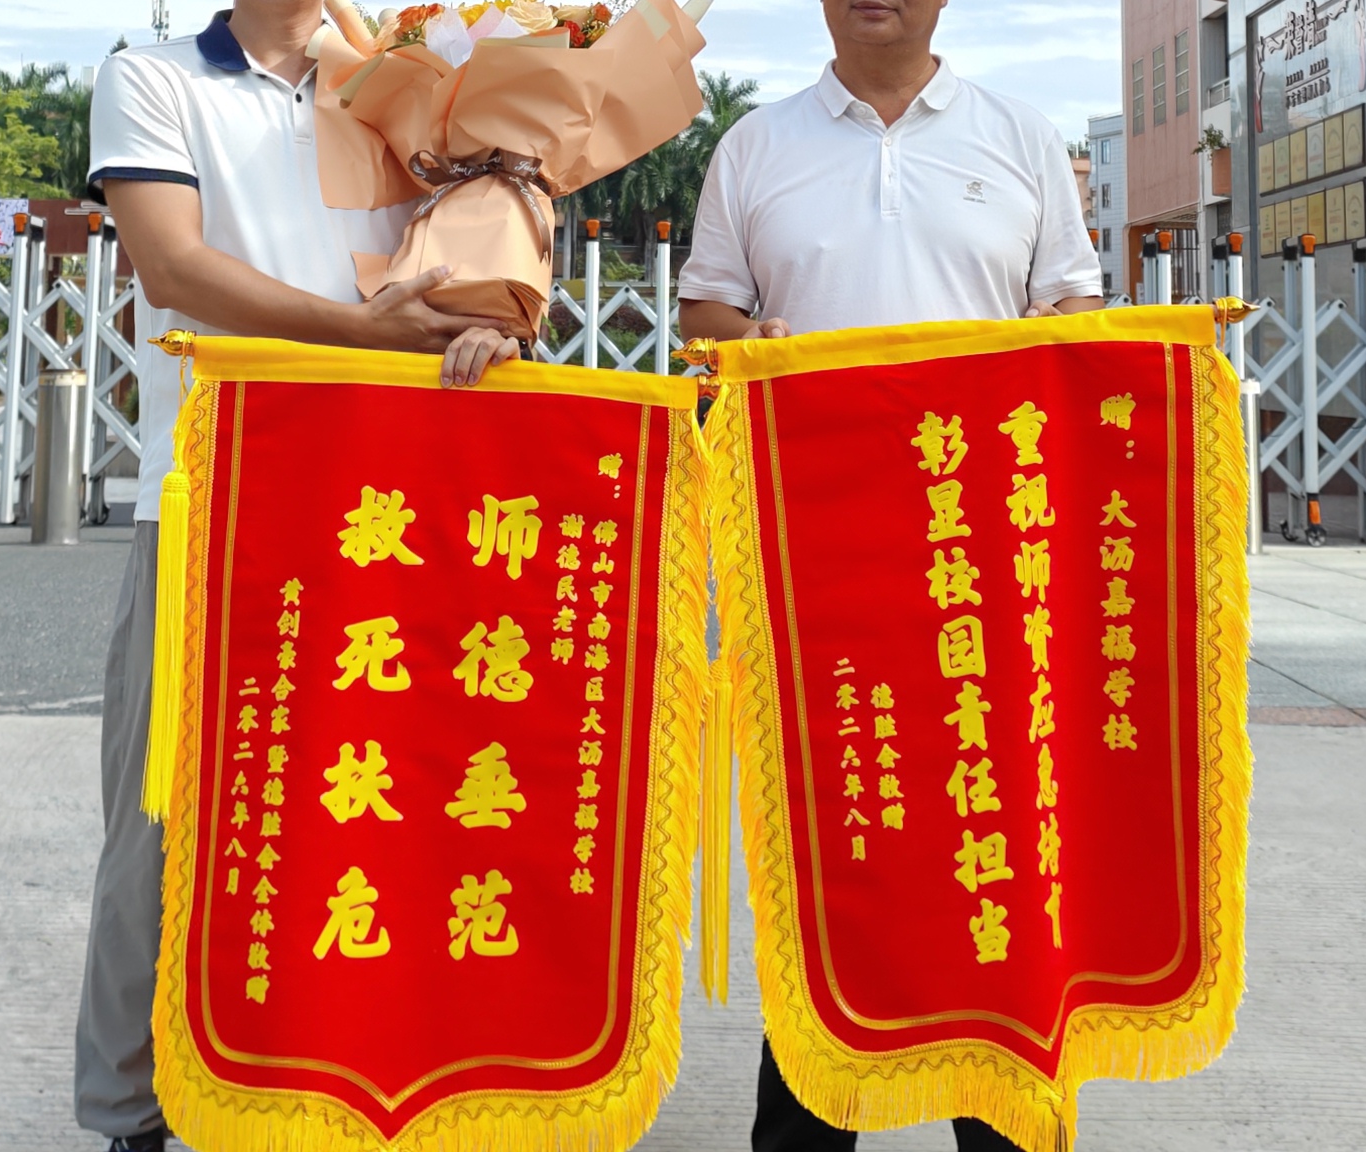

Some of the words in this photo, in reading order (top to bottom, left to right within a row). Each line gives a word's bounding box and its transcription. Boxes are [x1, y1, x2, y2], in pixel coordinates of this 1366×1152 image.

[312, 485, 425, 960] 救死扶危
[444, 493, 543, 961] 师德垂范
[550, 513, 585, 666] 谢德民老师
[569, 520, 620, 896] 佛山市南海区大沥嘉福学校
[910, 410, 1015, 965] 彰显校园责任担当
[1099, 489, 1138, 751] 大沥嘉福学校
[223, 677, 261, 896] 二零二六年八月
[832, 657, 871, 862] 二零二六年八月
